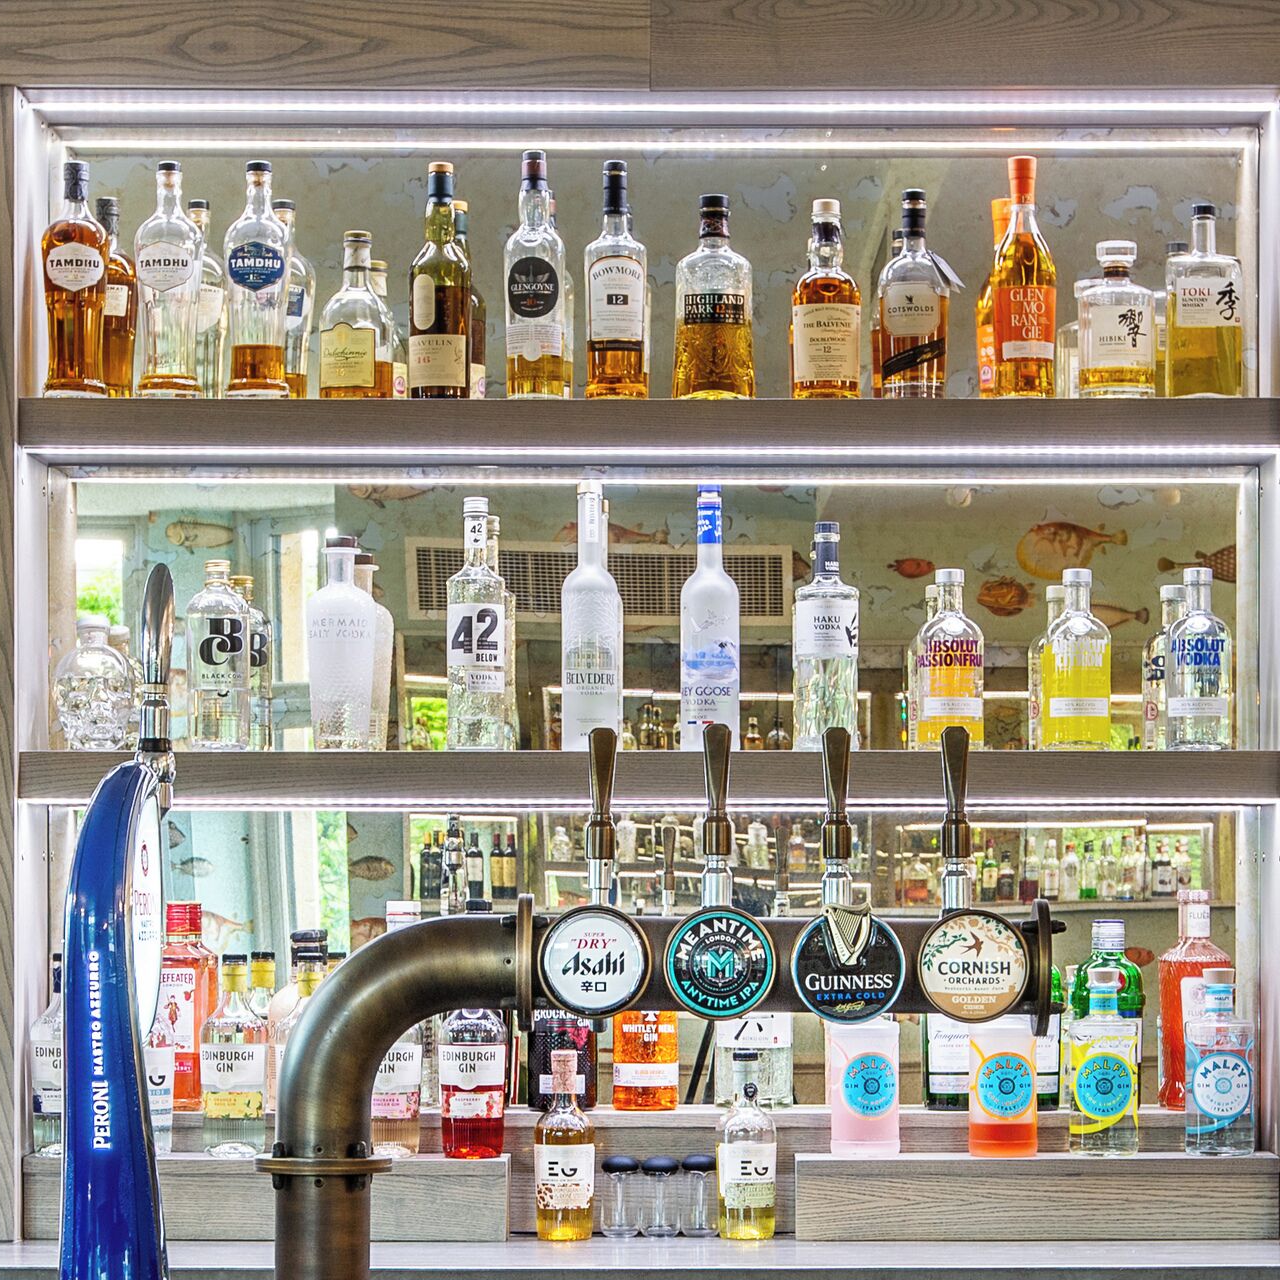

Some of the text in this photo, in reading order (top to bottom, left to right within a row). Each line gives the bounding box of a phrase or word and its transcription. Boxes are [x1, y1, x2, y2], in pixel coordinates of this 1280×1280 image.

[49, 259, 99, 268] TAMDHU
[139, 258, 188, 268] TAMDHU
[230, 258, 280, 269] TAMDHU
[592, 266, 641, 281] BOWMORE
[511, 282, 555, 292] GLENGOYNE
[1181, 288, 1212, 296] TOKI
[611, 296, 624, 304] 12
[685, 295, 744, 305] HIGHLAND
[1010, 288, 1044, 302] GLEN
[685, 305, 726, 314] PARK 12
[888, 306, 935, 314] COTSWOLDS
[1023, 301, 1045, 314] MO
[1011, 314, 1037, 327] RAN
[1022, 326, 1042, 339] GIE
[469, 522, 483, 534] 42
[311, 618, 368, 628] MERMAID
[813, 615, 841, 623] HAKU
[451, 608, 499, 654] 42
[925, 639, 979, 653] ABSOLUT
[1170, 639, 1226, 652] ABSOLUT
[475, 653, 499, 662] BELOW
[1176, 653, 1221, 667] VODKA
[566, 671, 616, 686] BELVEDERE
[695, 686, 732, 696] GOOSE
[676, 918, 766, 961] MEANTIME
[705, 934, 737, 944] LONDON
[562, 951, 625, 976] Asahi
[938, 961, 1011, 976] CORNISH
[805, 973, 894, 991] GUINNESS
[948, 976, 1001, 984] ORCHARDS
[580, 981, 607, 992] 辛口
[681, 980, 739, 1008] ANYTIME
[739, 982, 760, 1000] IPA
[817, 991, 885, 1000] EXTRA COLD
[951, 995, 997, 1003] GOLDEN
[622, 1024, 657, 1033] WHITLEY
[643, 1033, 658, 1042] GIN
[35, 1046, 61, 1057] EDINB
[89, 951, 111, 1150] PERONI NASTRO AZZURRO
[202, 1050, 254, 1061] EDINBURGH
[442, 1051, 496, 1061] EDINBURGH
[216, 1063, 233, 1073] GIN
[458, 1063, 476, 1073] GIN
[848, 1059, 894, 1079] MALFY
[983, 1059, 1030, 1079] MALFY
[1082, 1059, 1128, 1079] MALFY
[1200, 1059, 1247, 1079] MALFY
